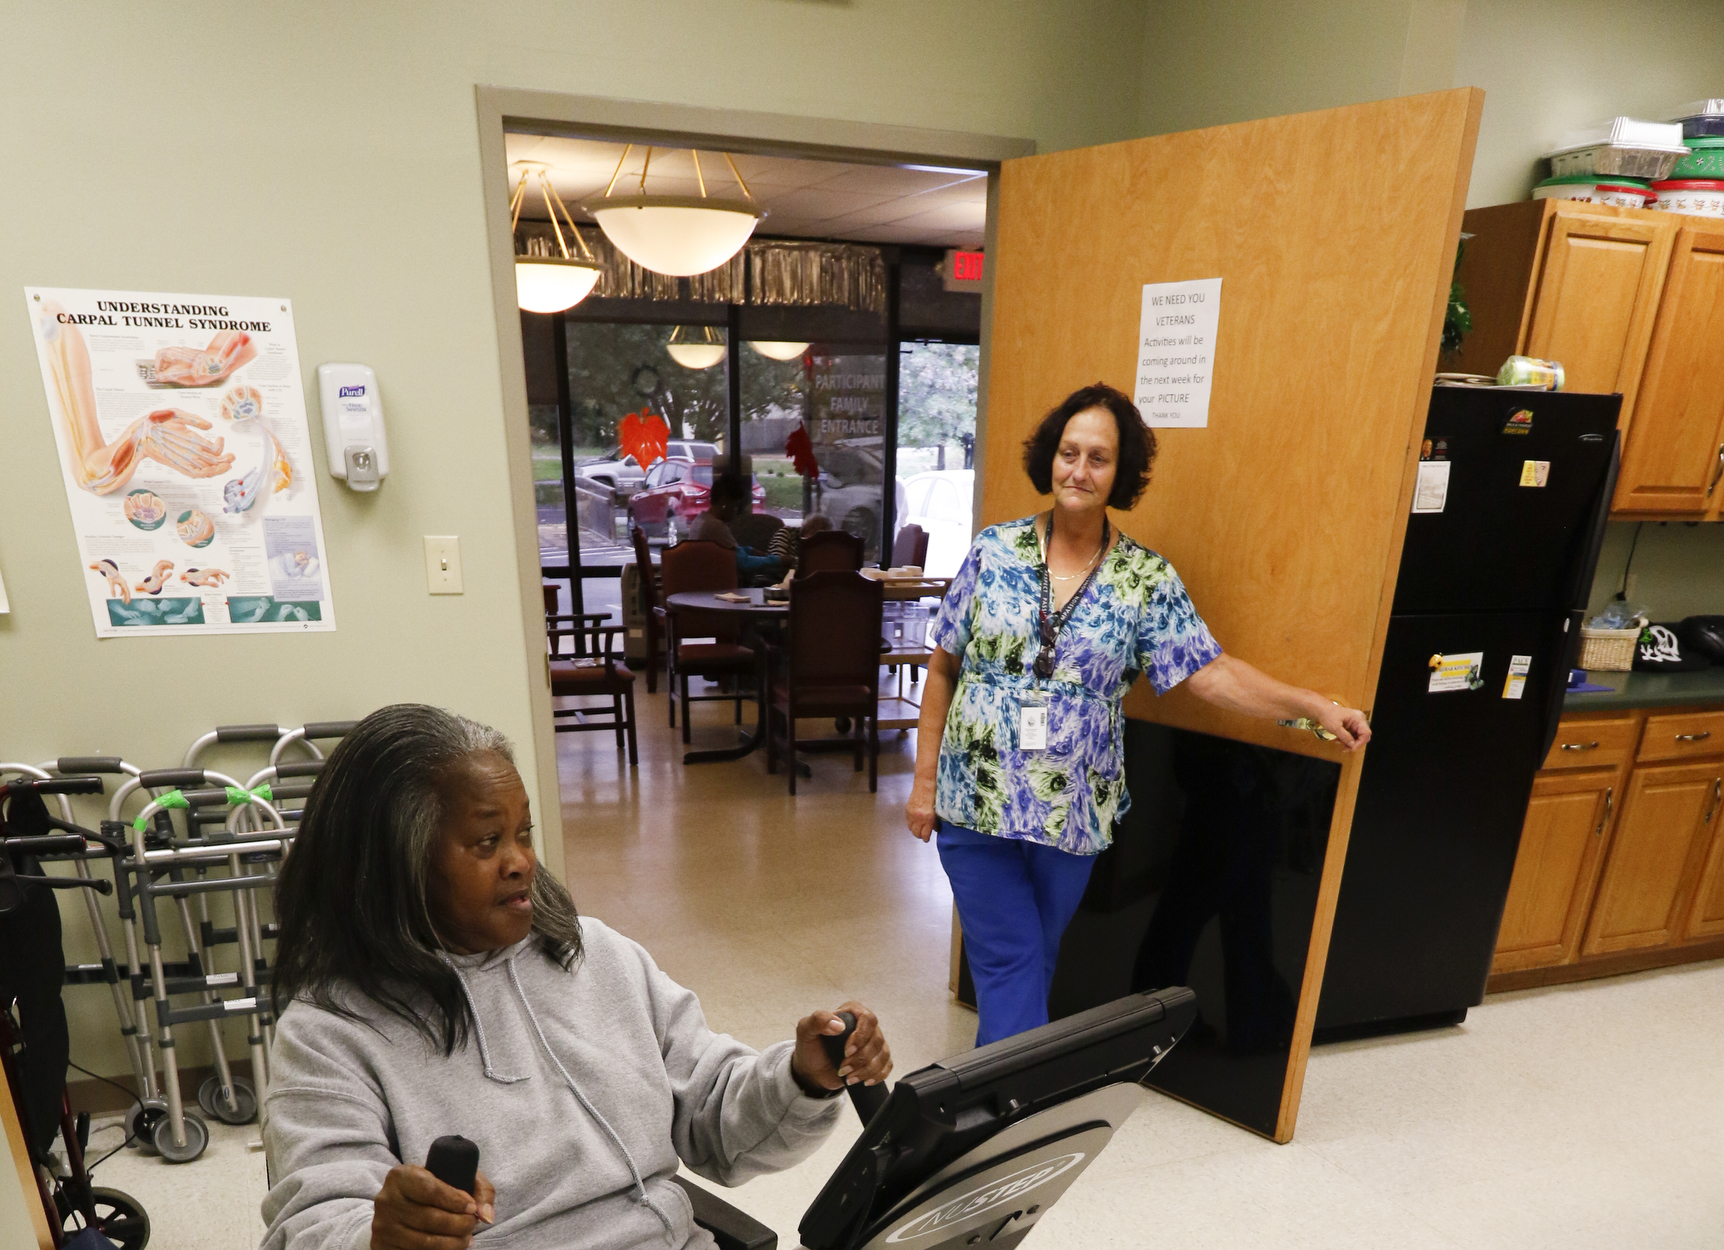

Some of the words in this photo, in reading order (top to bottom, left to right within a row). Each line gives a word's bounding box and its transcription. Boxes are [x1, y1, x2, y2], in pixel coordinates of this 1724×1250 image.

[954, 251, 985, 280] EXIT
[1151, 296, 1163, 306] WE
[1165, 294, 1186, 305] NEED
[1188, 293, 1205, 304] YOU
[96, 300, 229, 317] UNDERSTANDING
[56, 312, 117, 326] CARPAL
[122, 316, 184, 329] TUNNEL
[189, 319, 272, 332] SYNDROME
[1155, 314, 1195, 326] VETERANS
[1144, 337, 1176, 347] Activities
[1178, 335, 1192, 346] will
[1193, 335, 1203, 345] be
[1142, 357, 1168, 368] coming
[1170, 355, 1197, 366] around
[1198, 355, 1206, 365] in
[1140, 376, 1153, 385] the
[1154, 376, 1170, 385] next
[1171, 374, 1191, 384] week
[1193, 374, 1205, 384] for
[341, 387, 363, 396] Purell
[830, 396, 869, 412] FAMILY
[1138, 395, 1155, 406] your
[1157, 393, 1190, 404] PICTURE
[821, 419, 879, 434] ENTRANCE
[917, 1166, 1055, 1232] NUSTEP
